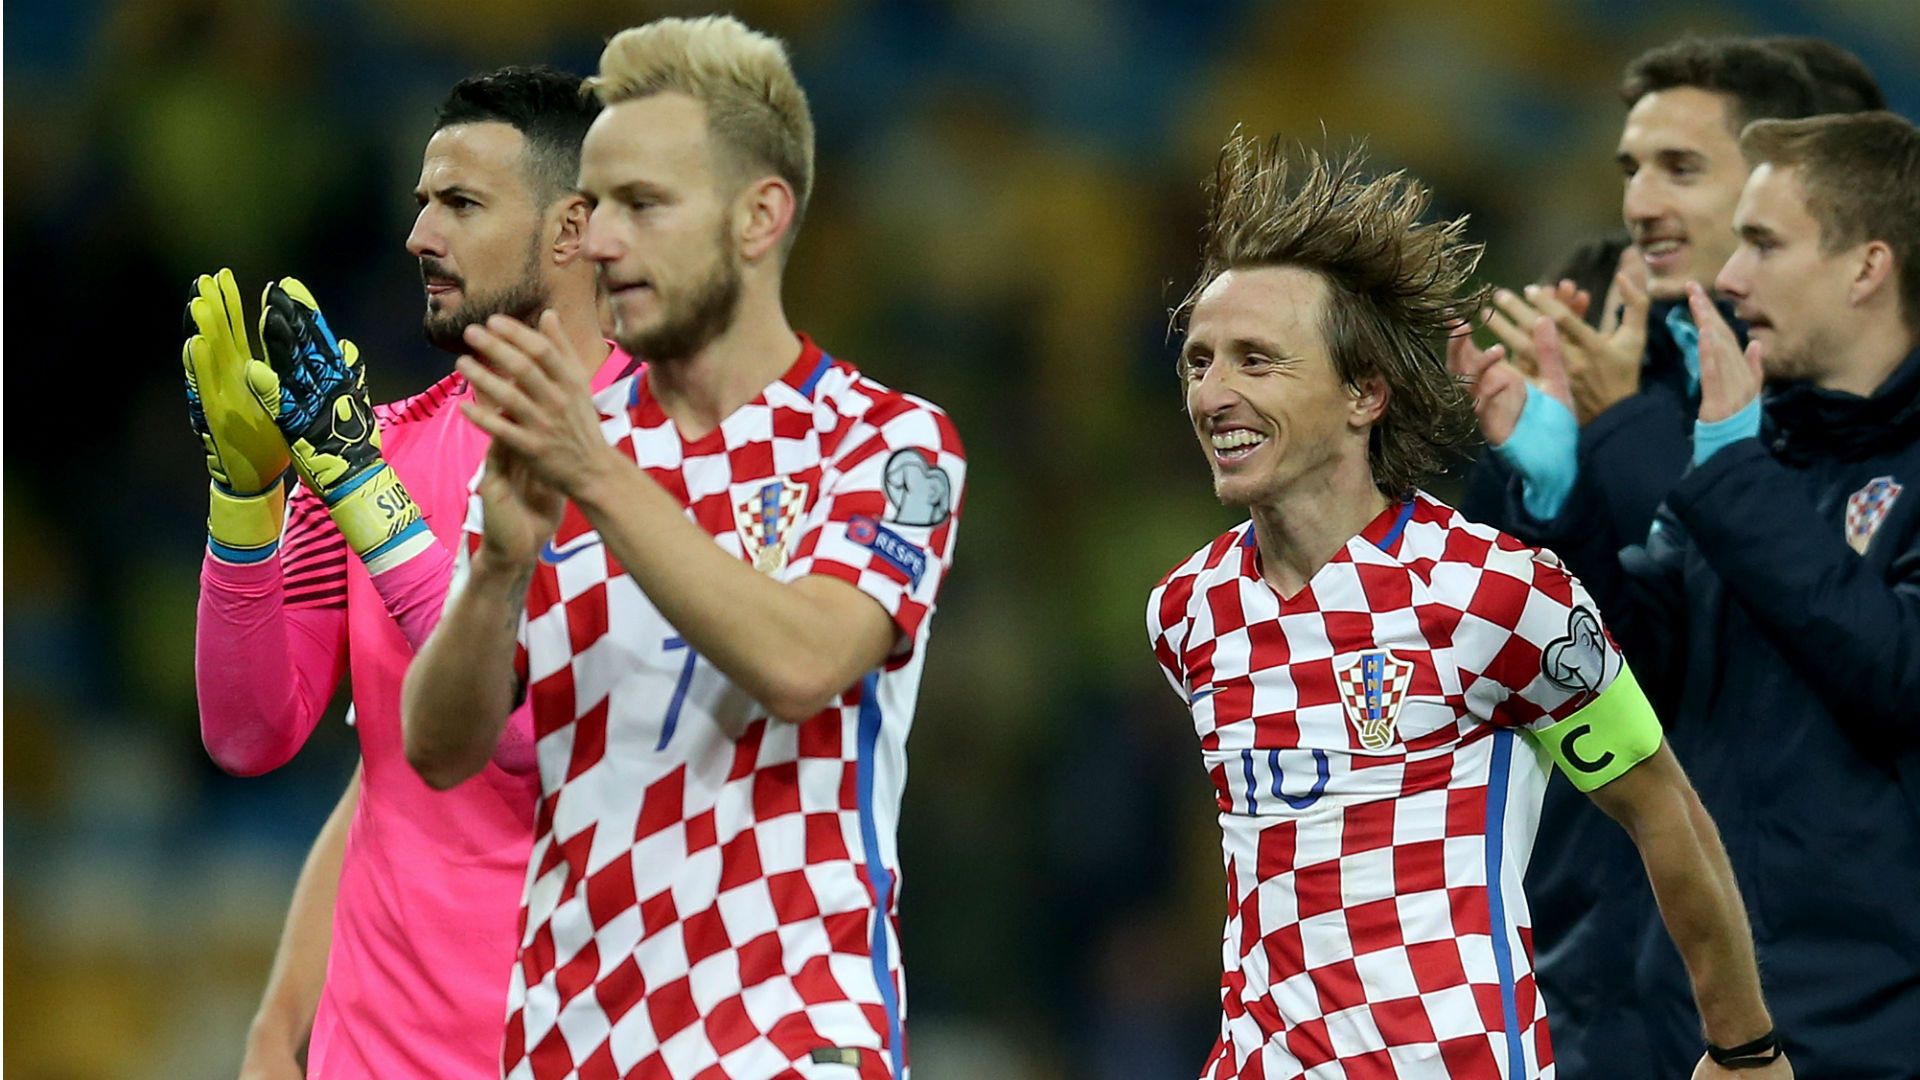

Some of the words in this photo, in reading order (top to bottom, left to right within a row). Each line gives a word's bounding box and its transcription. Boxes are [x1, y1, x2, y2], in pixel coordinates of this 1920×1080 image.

[653, 636, 698, 752] 7
[1367, 660, 1379, 710] HNS
[1560, 724, 1615, 774] C
[1241, 748, 1331, 816] 10
